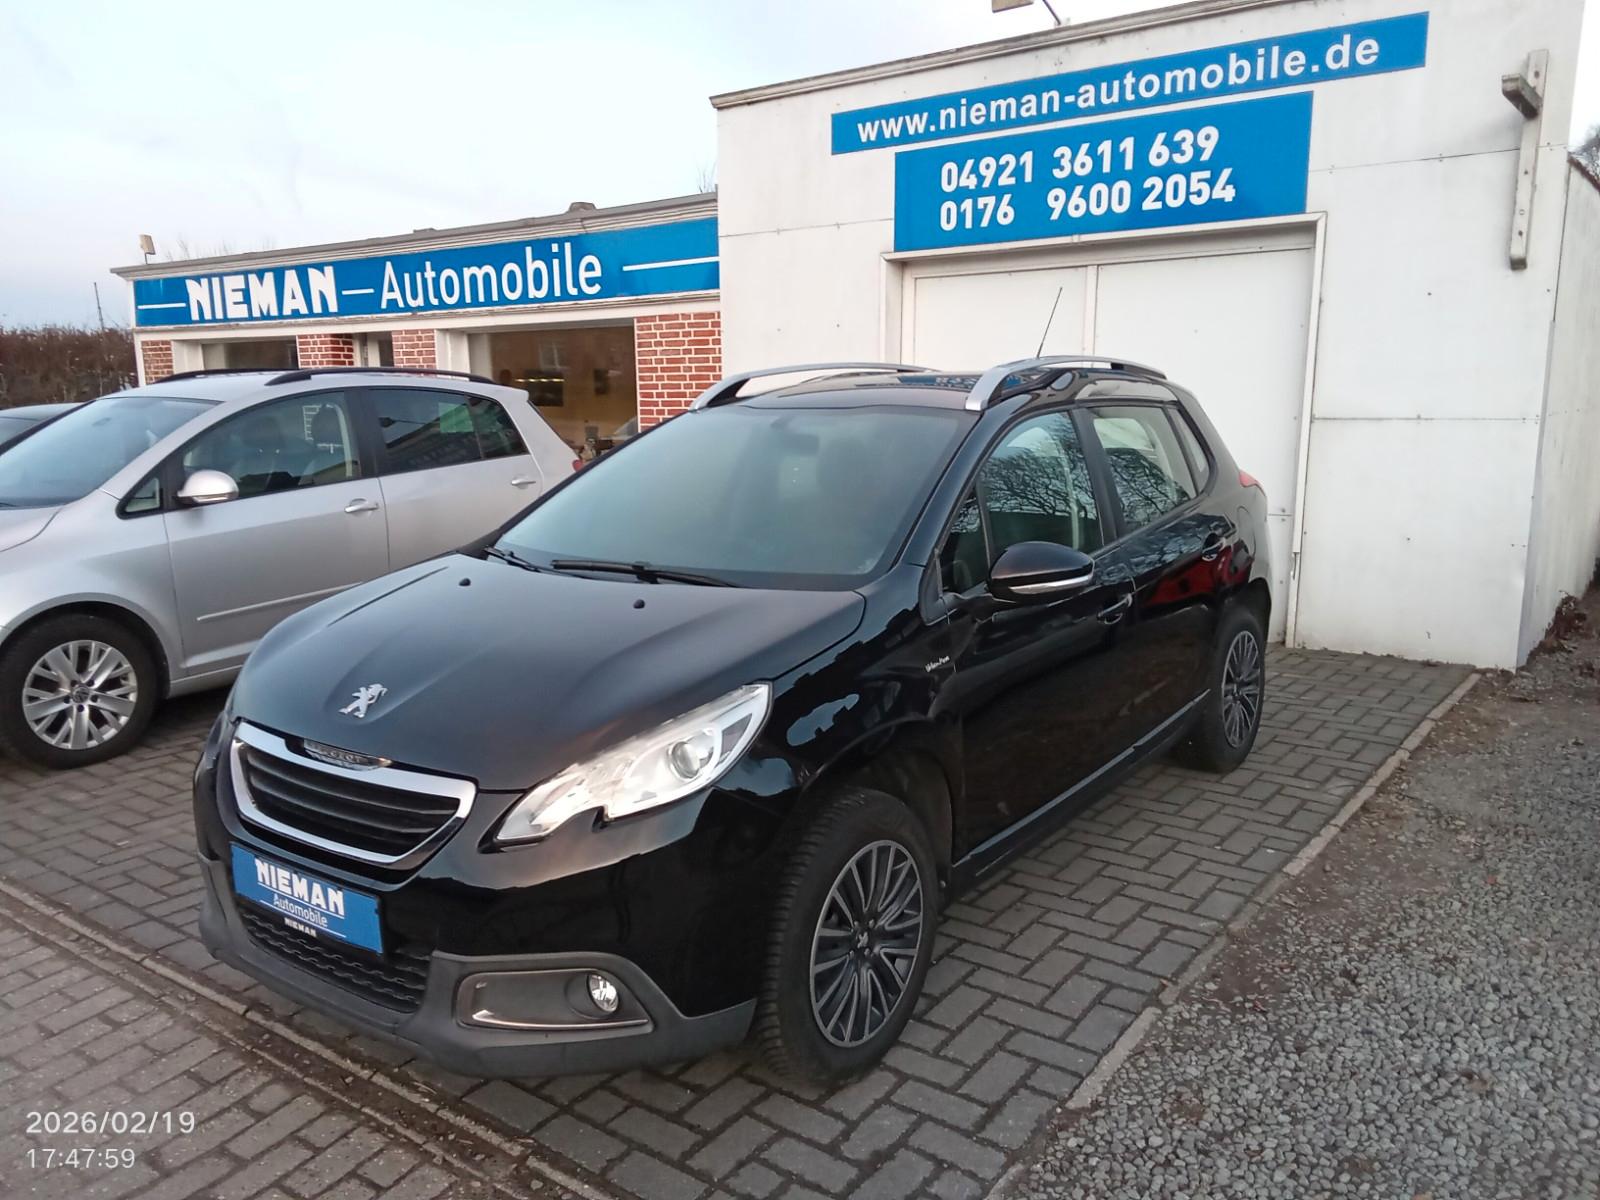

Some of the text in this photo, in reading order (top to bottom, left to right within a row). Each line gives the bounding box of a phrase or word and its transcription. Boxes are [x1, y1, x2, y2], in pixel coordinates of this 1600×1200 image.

[857, 34, 1379, 143] www.nieman-automobile.de
[941, 126, 1219, 193] 04921 3611 639
[940, 168, 1236, 231] 0176 9600 2054
[185, 242, 602, 321] NIEMAN Automobile
[254, 857, 345, 916] NIEMAN
[273, 893, 328, 927] Automobile
[284, 917, 317, 938] NIEMAN
